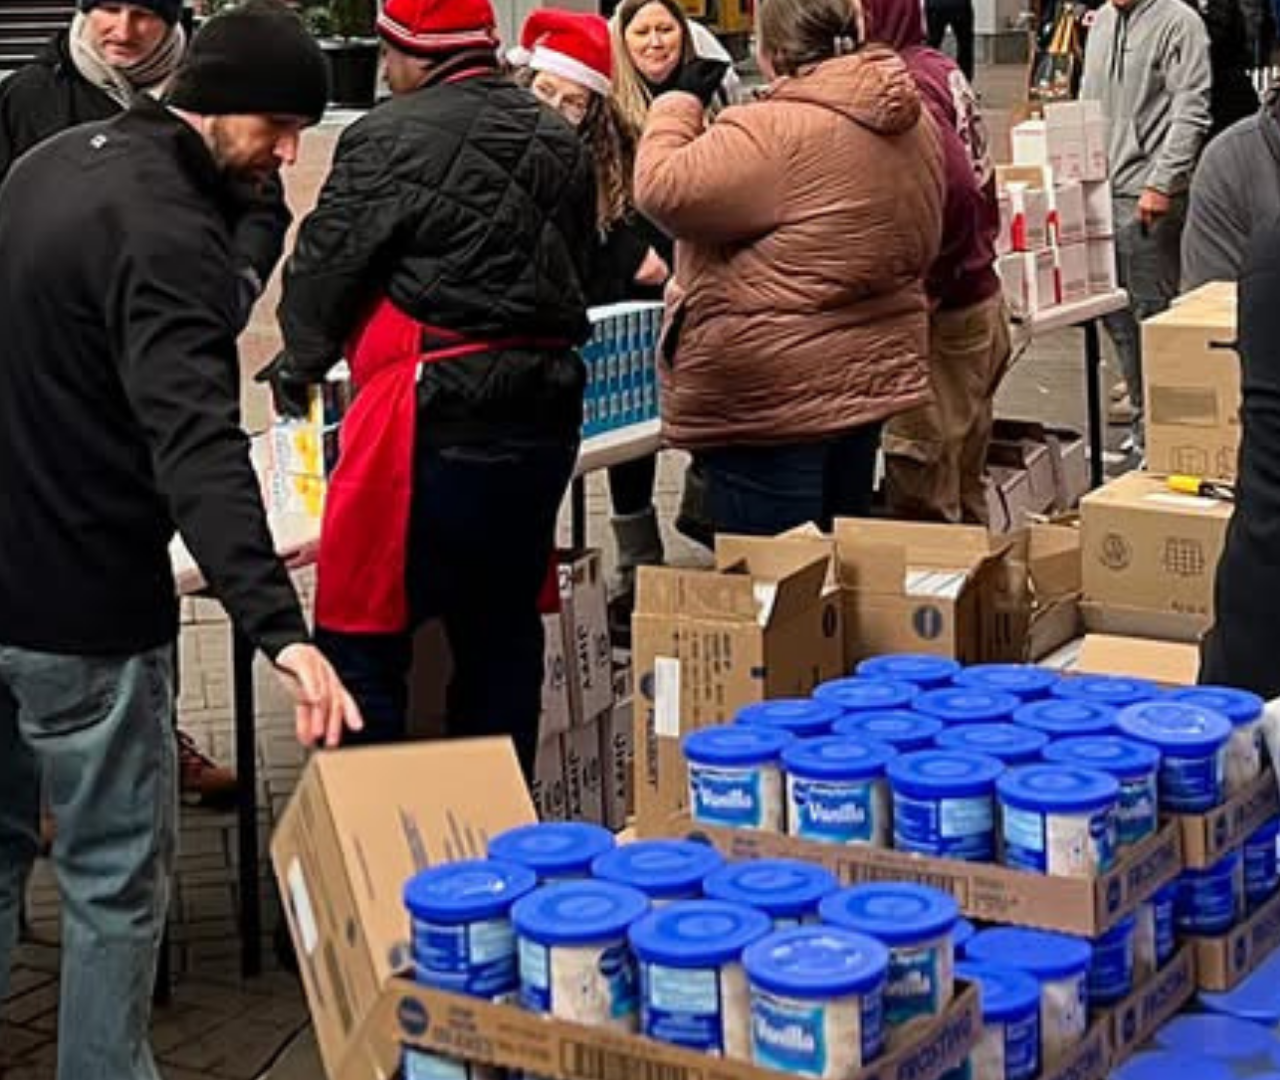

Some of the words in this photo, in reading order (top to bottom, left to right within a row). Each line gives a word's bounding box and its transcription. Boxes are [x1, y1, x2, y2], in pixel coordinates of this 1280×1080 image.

[700, 788, 753, 809] Vanilla
[809, 801, 866, 823] Vanilla
[756, 1018, 816, 1051] Vanilla
